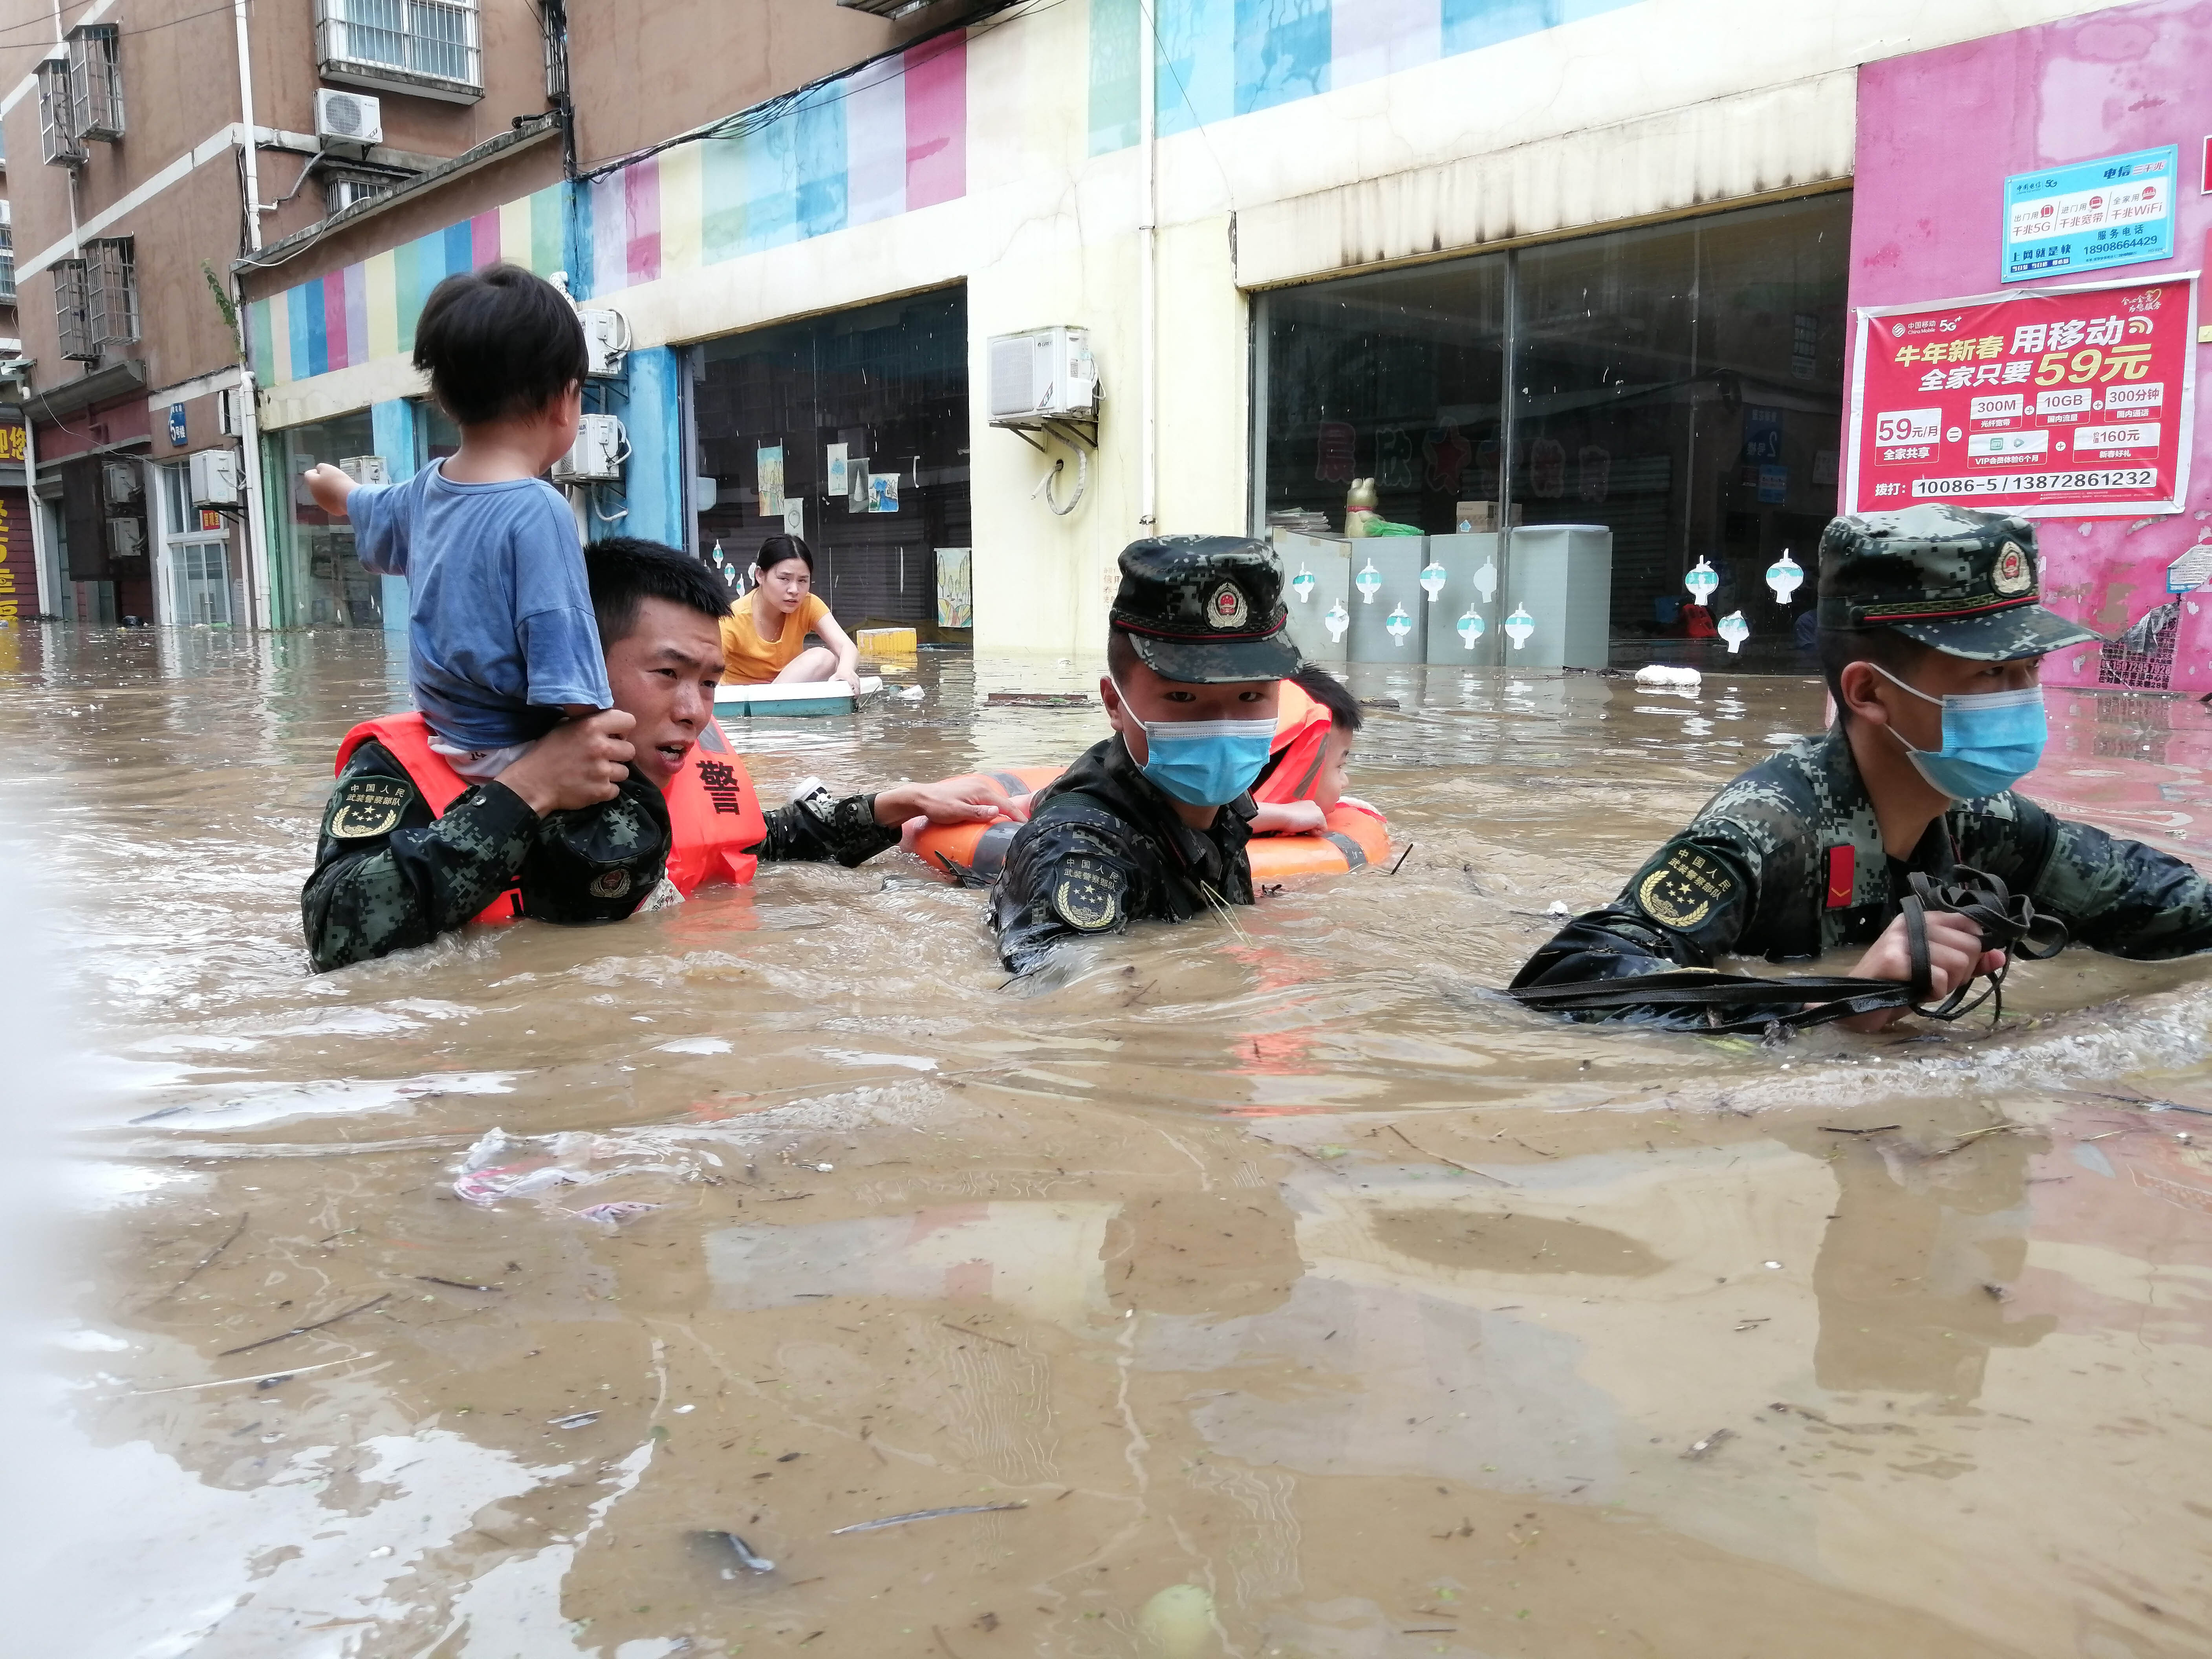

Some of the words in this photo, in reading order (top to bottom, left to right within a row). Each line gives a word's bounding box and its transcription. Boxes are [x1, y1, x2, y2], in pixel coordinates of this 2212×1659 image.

[2014, 211, 2039, 222] 出门用
[2111, 202, 2163, 220] 千兆WiFi
[2059, 212, 2104, 229] 千兆宽带
[2012, 222, 2051, 236] 千兆5G
[2098, 224, 2144, 241] 服务电话
[2084, 235, 2158, 255] 18908664429
[2011, 244, 2071, 263] 上网就是快
[1908, 320, 1936, 330] 中国移动
[1895, 335, 2004, 367] 牛年新春
[2009, 315, 2125, 355] 用移动
[1918, 360, 2034, 392] 全家只要
[2034, 344, 2152, 386] 59元
[2044, 395, 2083, 408] 10GB
[2109, 388, 2159, 403] 300分钟
[1977, 400, 2016, 412] 300M
[2116, 409, 2150, 419] 国内通话
[1981, 419, 2011, 428] 光纤宽带
[2047, 414, 2078, 423] 国内流量
[1879, 418, 1938, 441] 59元/月
[2100, 429, 2140, 442] 160元
[1883, 447, 1930, 461] 全家共享
[2099, 449, 2131, 459] 新春好礼
[1918, 478, 1998, 494] 10086-5
[2013, 471, 2151, 490] 13872861232
[351, 784, 405, 798] 中国人民
[695, 760, 740, 815] 警
[346, 794, 401, 806] 武装警察部队
[1067, 857, 1119, 883] 中国人民
[1678, 849, 1731, 892] 中国人民
[1064, 868, 1116, 892] 武装警察部队
[1668, 857, 1722, 901] 武装警察部队
